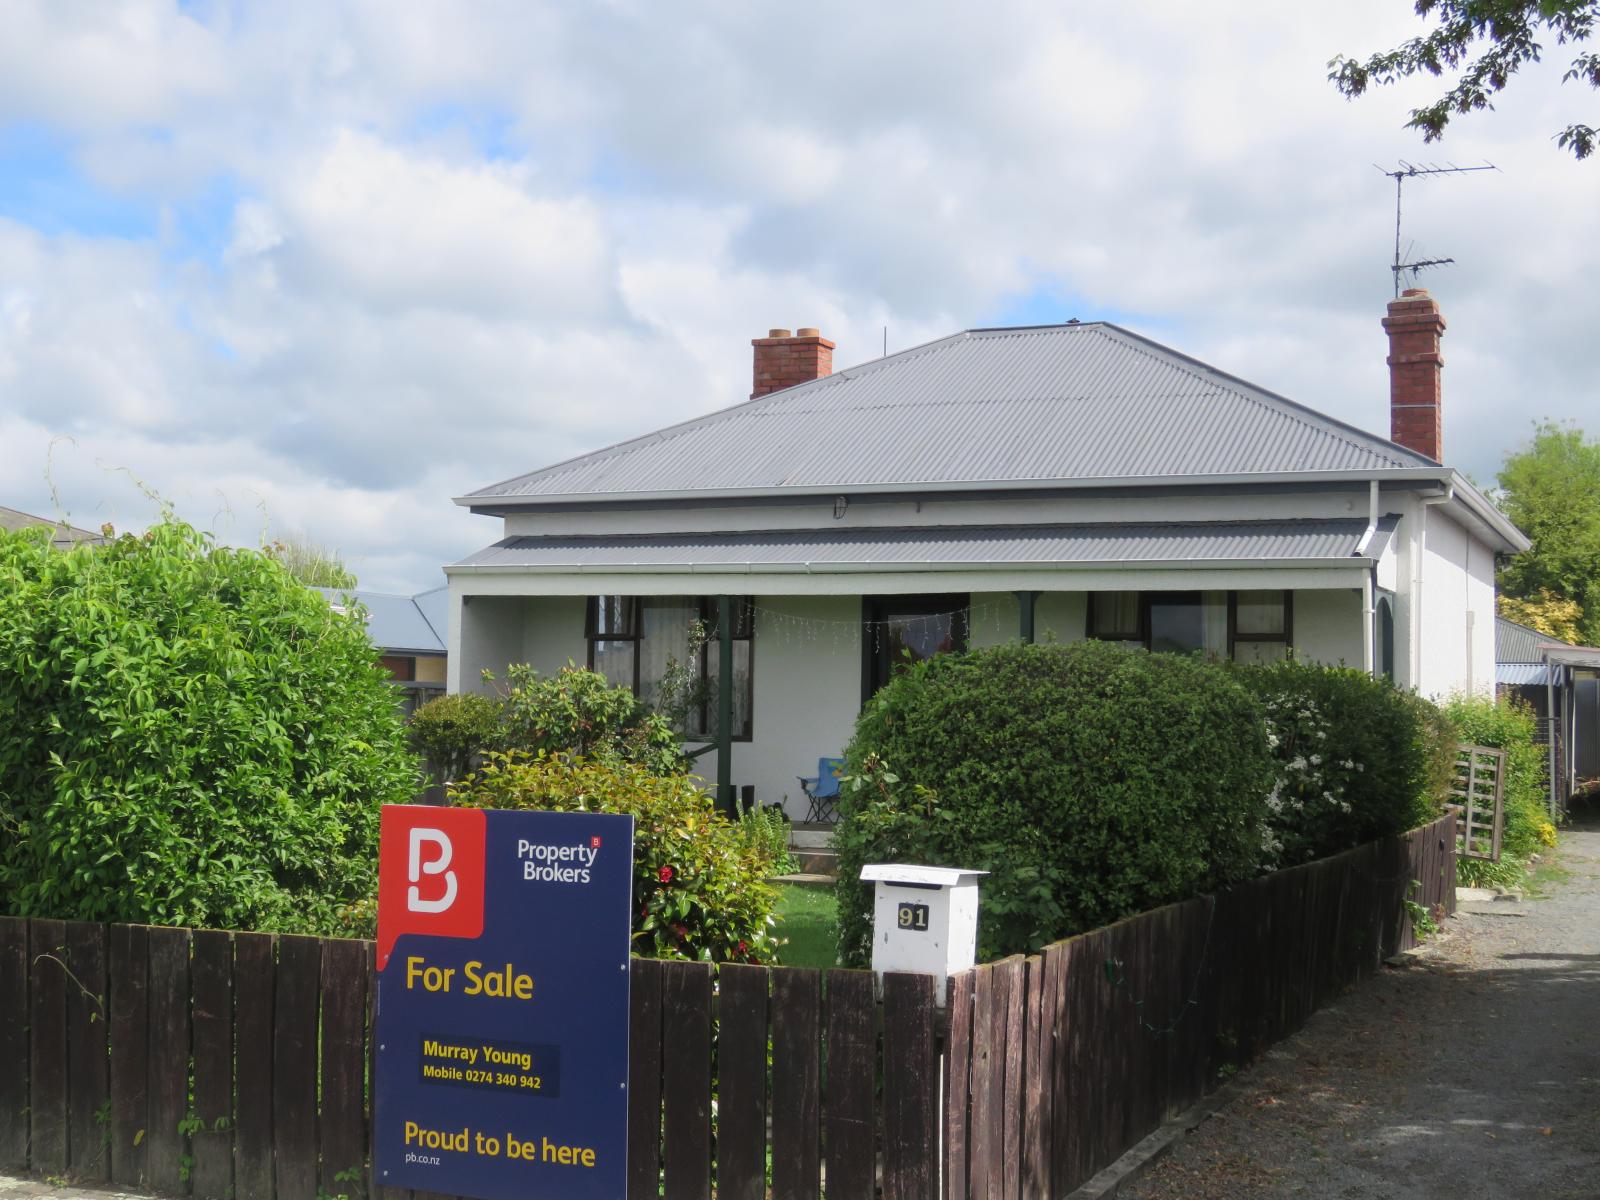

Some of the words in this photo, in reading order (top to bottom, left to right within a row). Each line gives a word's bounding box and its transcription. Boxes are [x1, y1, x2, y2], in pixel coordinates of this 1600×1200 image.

[518, 839, 598, 866] Property
[524, 861, 590, 884] Brokers
[899, 907, 926, 927] 91
[407, 956, 455, 993] For
[464, 960, 533, 999] Sale
[424, 1040, 478, 1065] Murray
[483, 1046, 531, 1070] Young
[423, 1065, 463, 1081] Mobile
[466, 1068, 493, 1084] 0274
[496, 1073, 517, 1087] 340
[520, 1075, 541, 1089] 942
[405, 1121, 469, 1153] Proud
[475, 1132, 499, 1156] to
[507, 1133, 536, 1160] be
[542, 1136, 596, 1168] here
[405, 1152, 441, 1166] pb.co.nz
